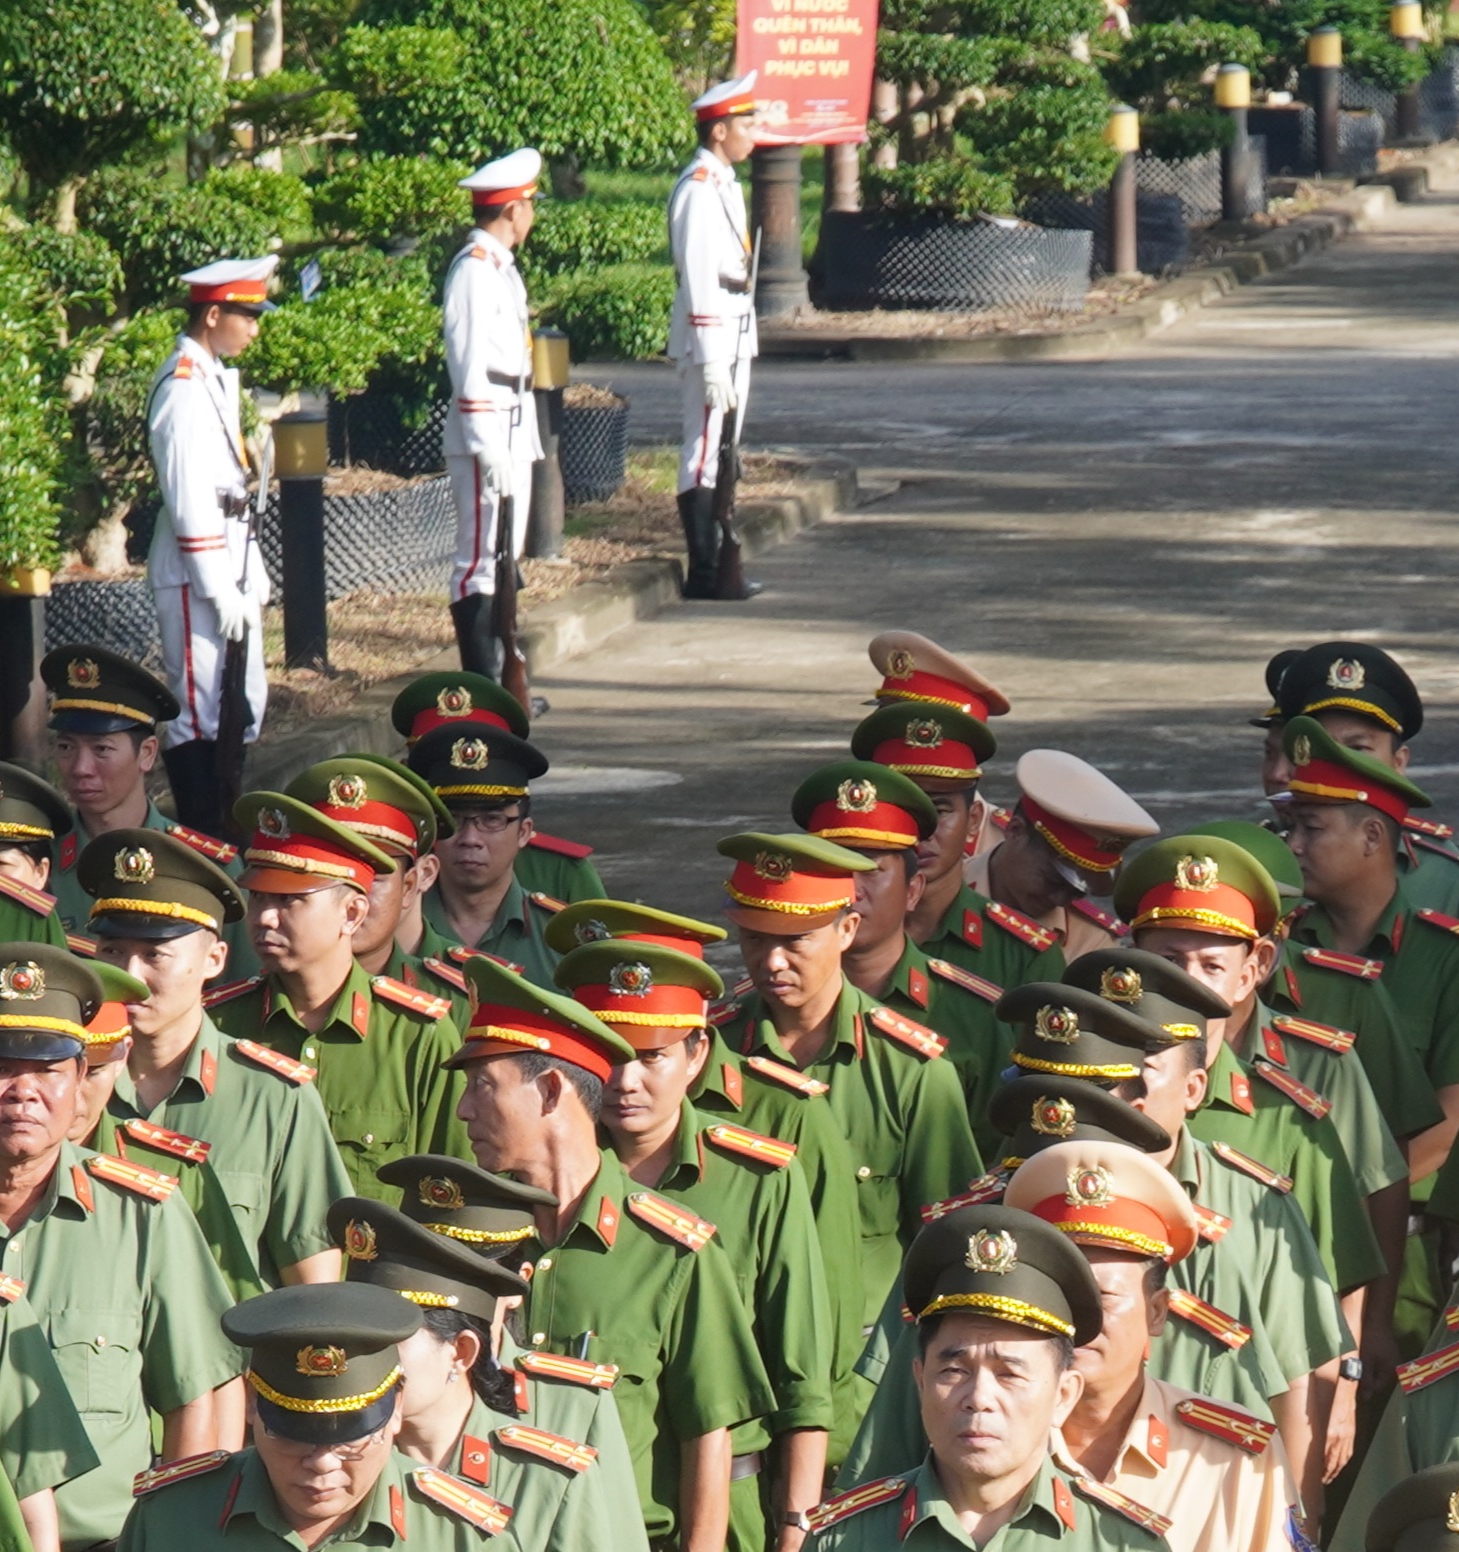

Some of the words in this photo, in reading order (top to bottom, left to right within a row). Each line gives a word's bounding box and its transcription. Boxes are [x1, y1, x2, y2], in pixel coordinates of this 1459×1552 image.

[753, 15, 807, 34] QUÊN
[810, 15, 863, 35] THÂN,
[800, 36, 839, 54] DÂN
[765, 60, 816, 78] PHỤC
